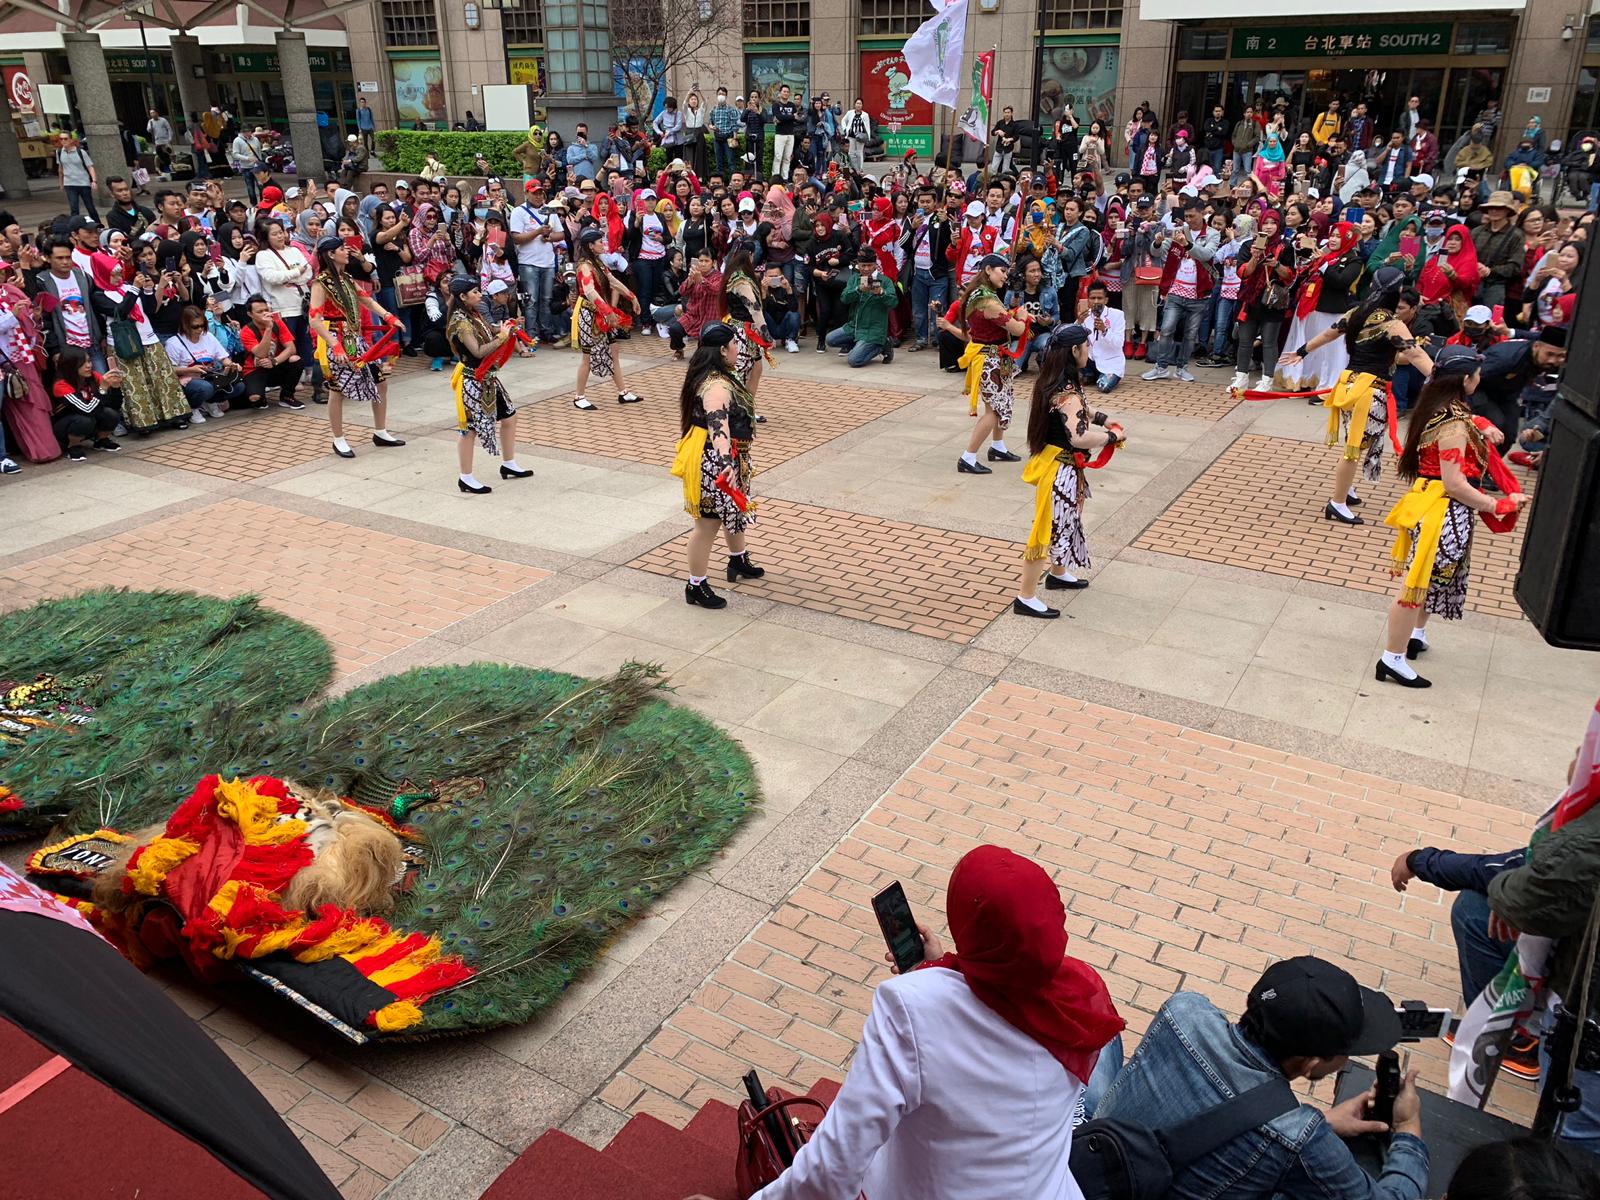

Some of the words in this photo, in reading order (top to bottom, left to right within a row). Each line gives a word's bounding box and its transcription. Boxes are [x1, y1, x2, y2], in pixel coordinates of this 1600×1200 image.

[1245, 35, 1261, 51] 南
[1267, 37, 1277, 50] 2
[1304, 34, 1372, 51] 台北車站
[1379, 34, 1430, 48] SOUTH
[1431, 33, 1442, 47] 2
